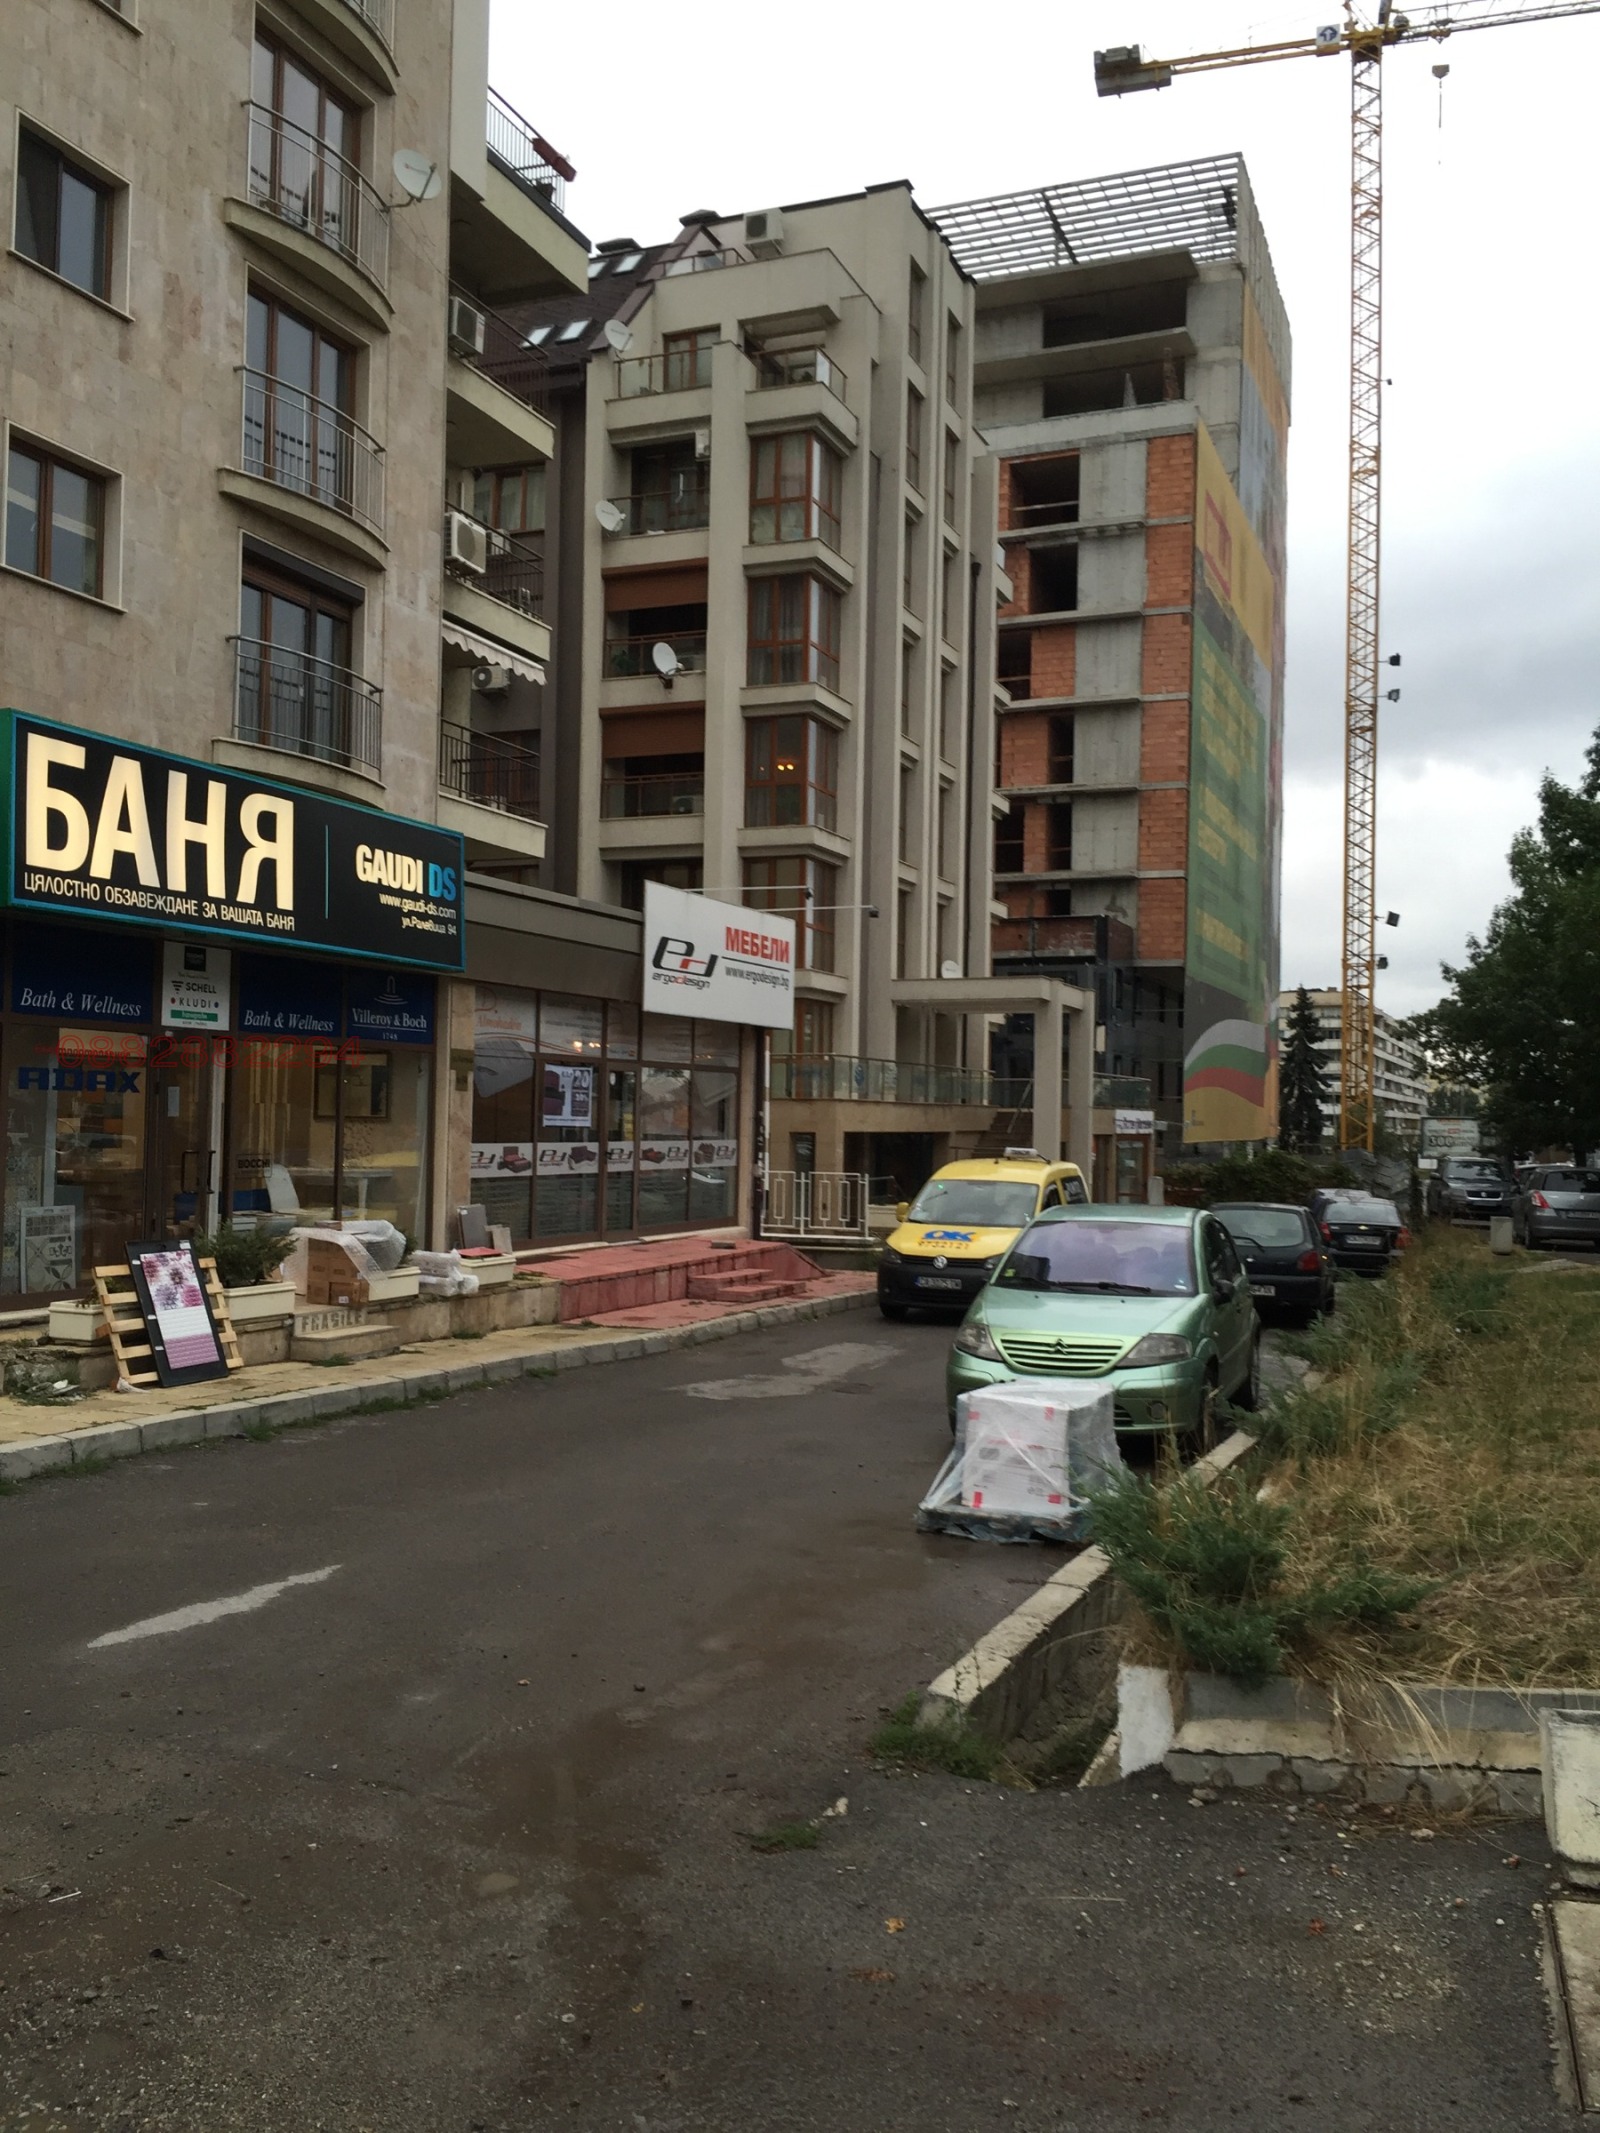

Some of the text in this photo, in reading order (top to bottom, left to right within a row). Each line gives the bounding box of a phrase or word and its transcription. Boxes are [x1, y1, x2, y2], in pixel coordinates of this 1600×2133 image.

[25, 731, 295, 911] БАНЯ
[356, 843, 457, 902] GAUDI DS
[24, 871, 296, 932] ЦЯЛОСТНО ОБЗАВЕЖДАНЕ ЗА ВАШАТА БАНЯ
[378, 892, 457, 920] www.gaudi-ds.com
[725, 925, 790, 964] МЕБЕЛИ
[185, 982, 217, 994] SCHELL
[652, 971, 711, 991] ergodesign
[724, 965, 790, 991] www.ergodesign.bg
[20, 987, 142, 1017] Bath & Wellness
[179, 997, 211, 1009] KLUDI
[244, 1009, 335, 1032] Bath & Wellness
[351, 1007, 427, 1029] Villeroy & Boch
[18, 1067, 141, 1094] ADAX
[237, 1158, 271, 1169] BOCCHI
